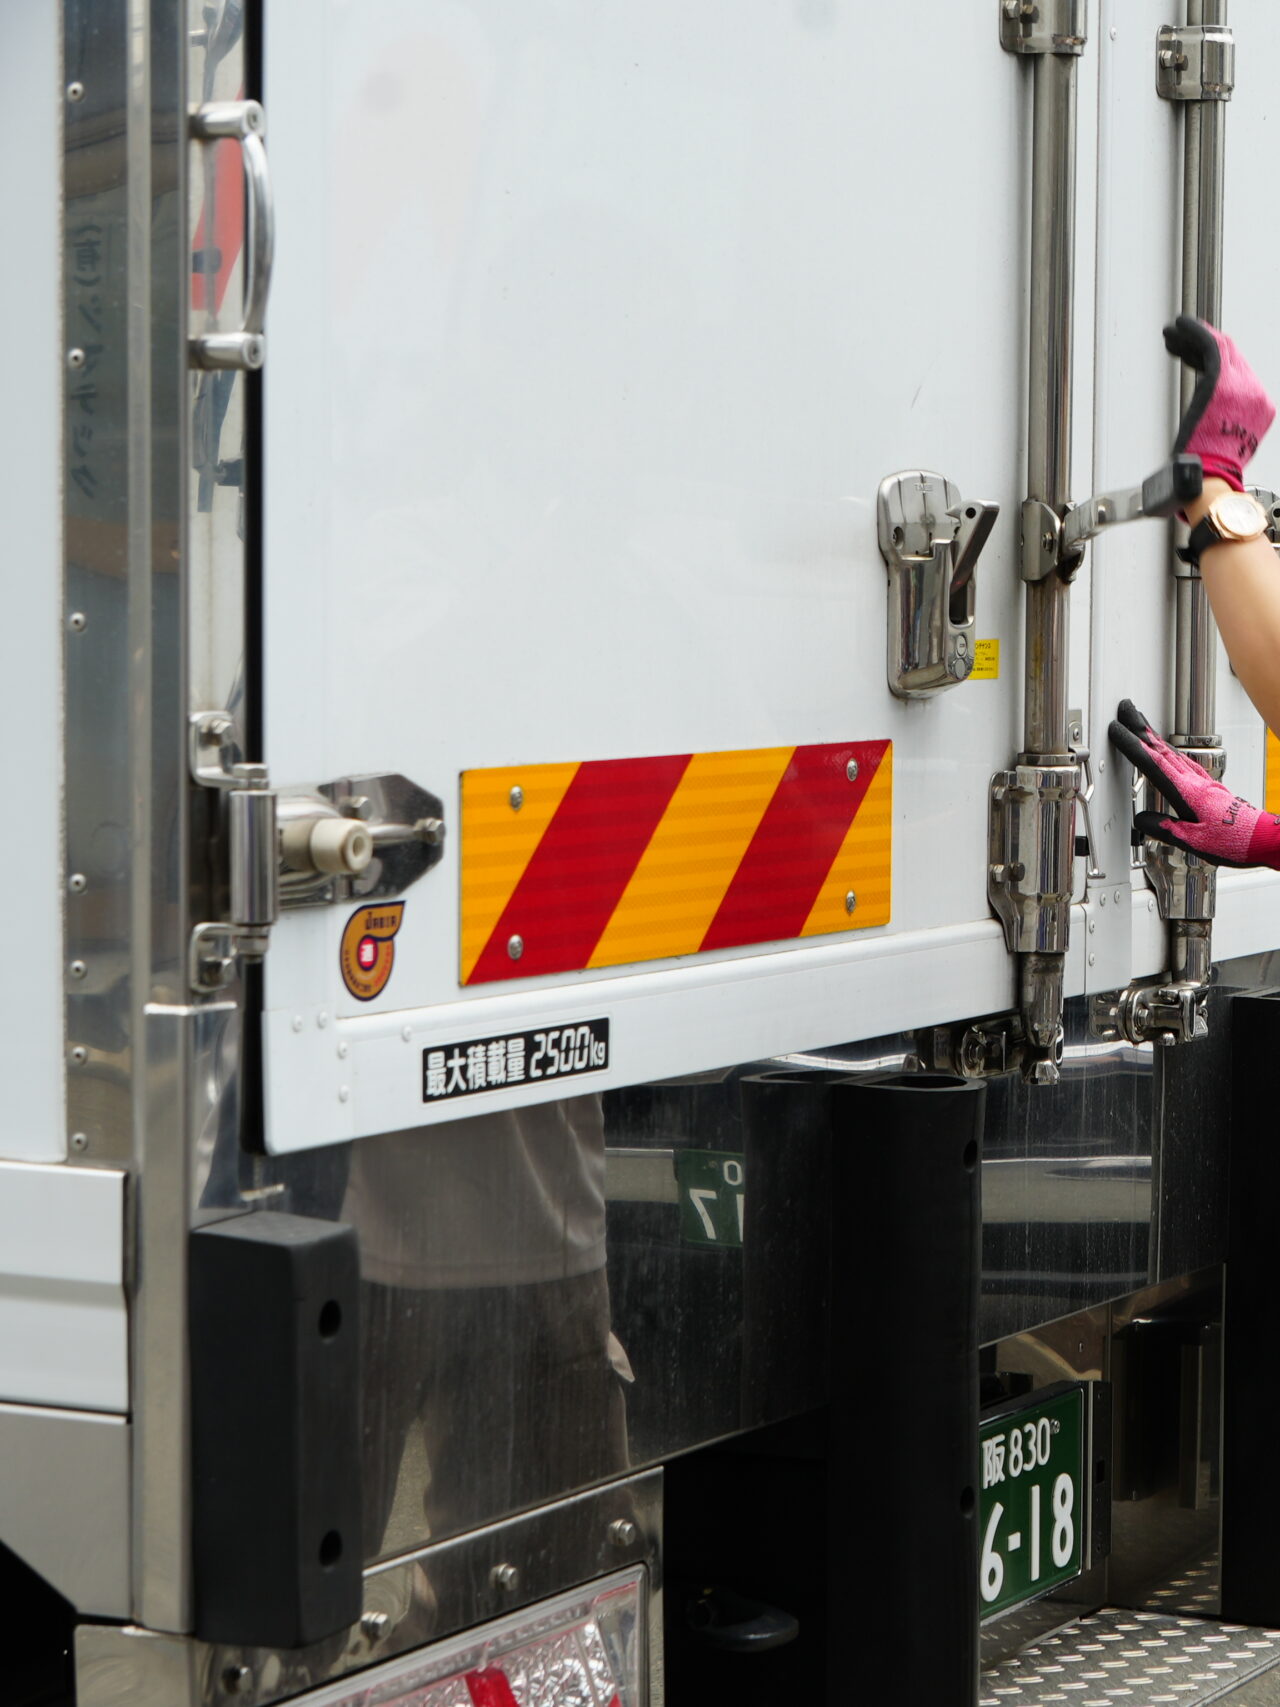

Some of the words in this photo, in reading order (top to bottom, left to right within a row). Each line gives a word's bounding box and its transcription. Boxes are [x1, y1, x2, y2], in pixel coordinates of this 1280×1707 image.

[426, 1037, 526, 1096] 最大積載量
[529, 1025, 606, 1078] 2500kg
[1009, 1416, 1050, 1478] 830
[979, 1472, 1074, 1603] 6-18
